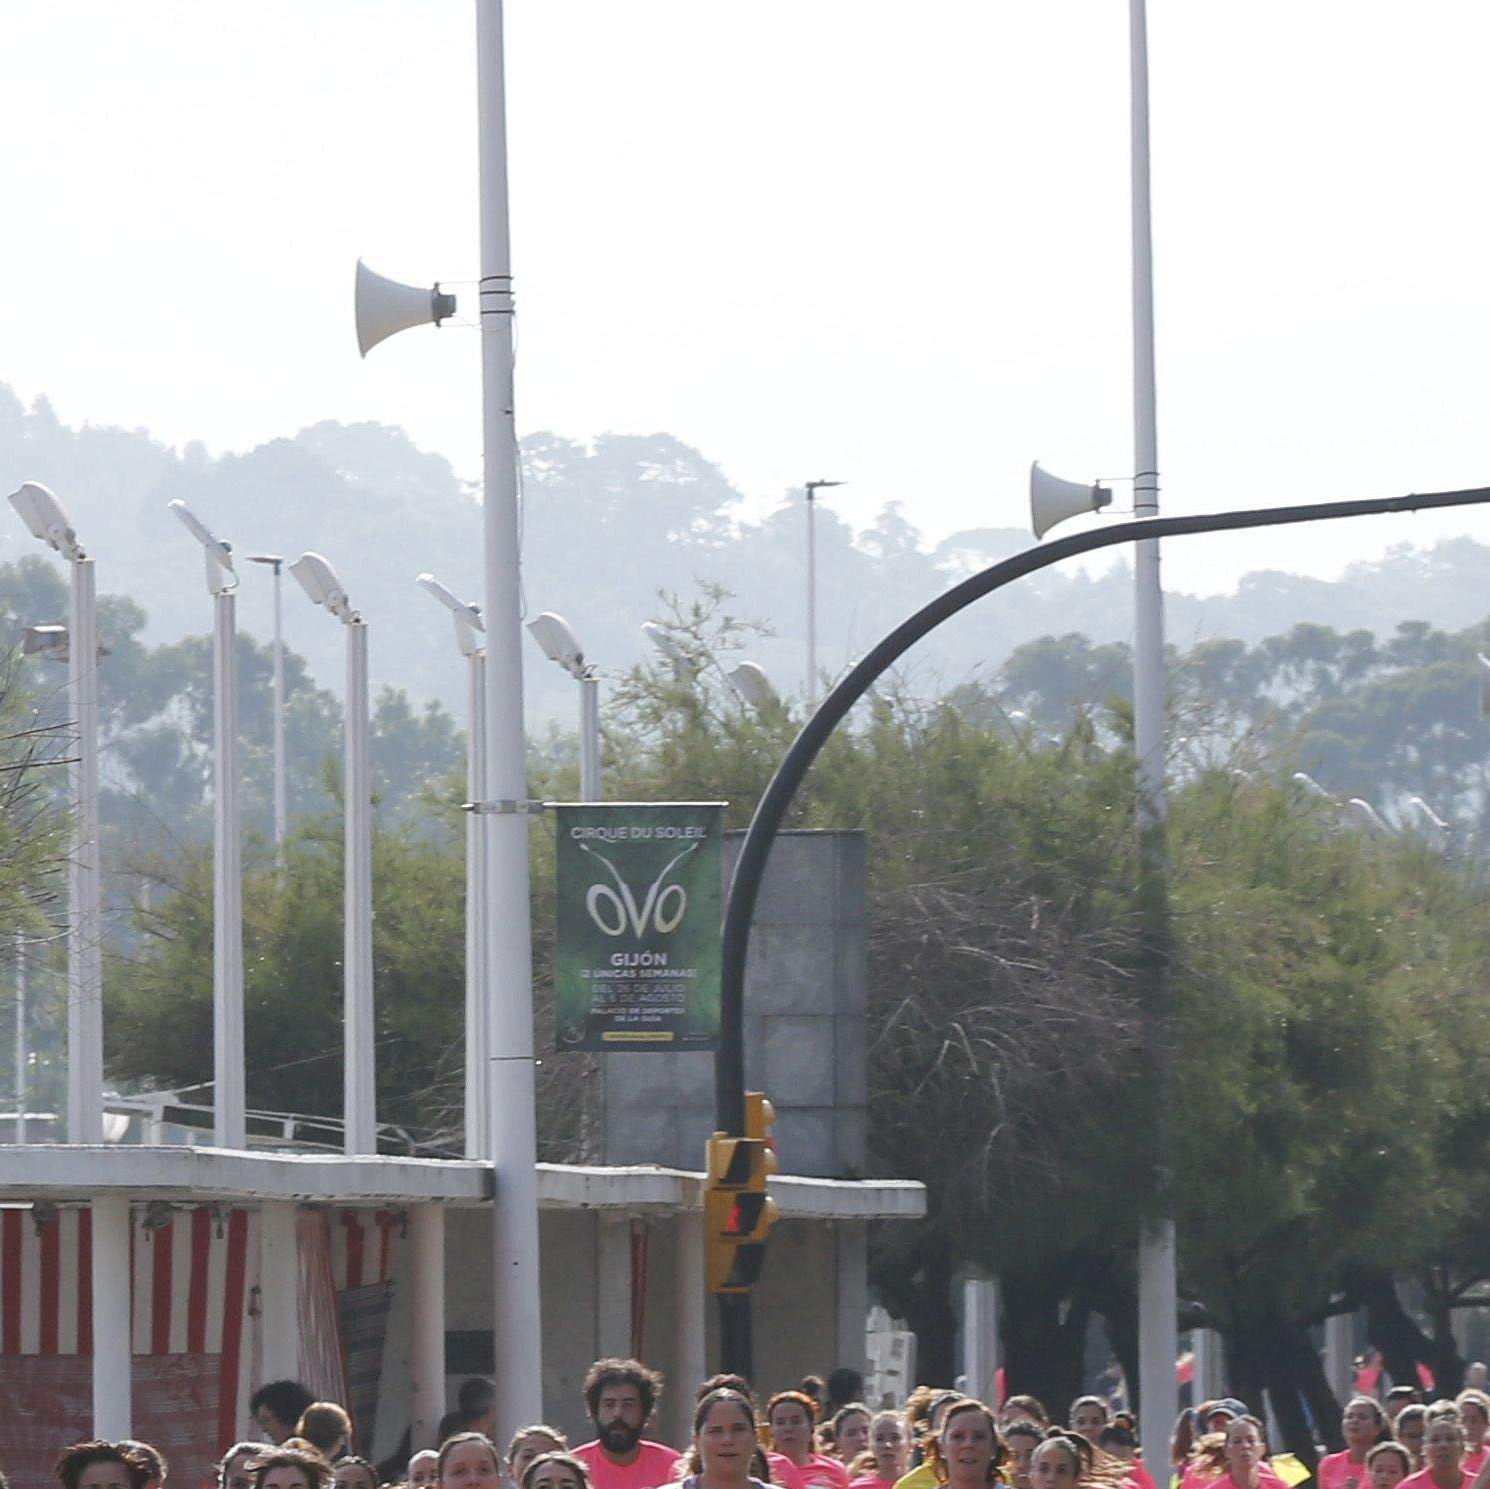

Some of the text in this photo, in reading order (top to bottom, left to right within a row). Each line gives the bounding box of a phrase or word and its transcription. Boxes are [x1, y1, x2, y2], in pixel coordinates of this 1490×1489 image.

[570, 826, 707, 843] CIRQUE DU SOLEIL
[581, 860, 693, 939] OVO
[610, 951, 668, 966] GIJÓN
[593, 967, 637, 978] ÚNICAS
